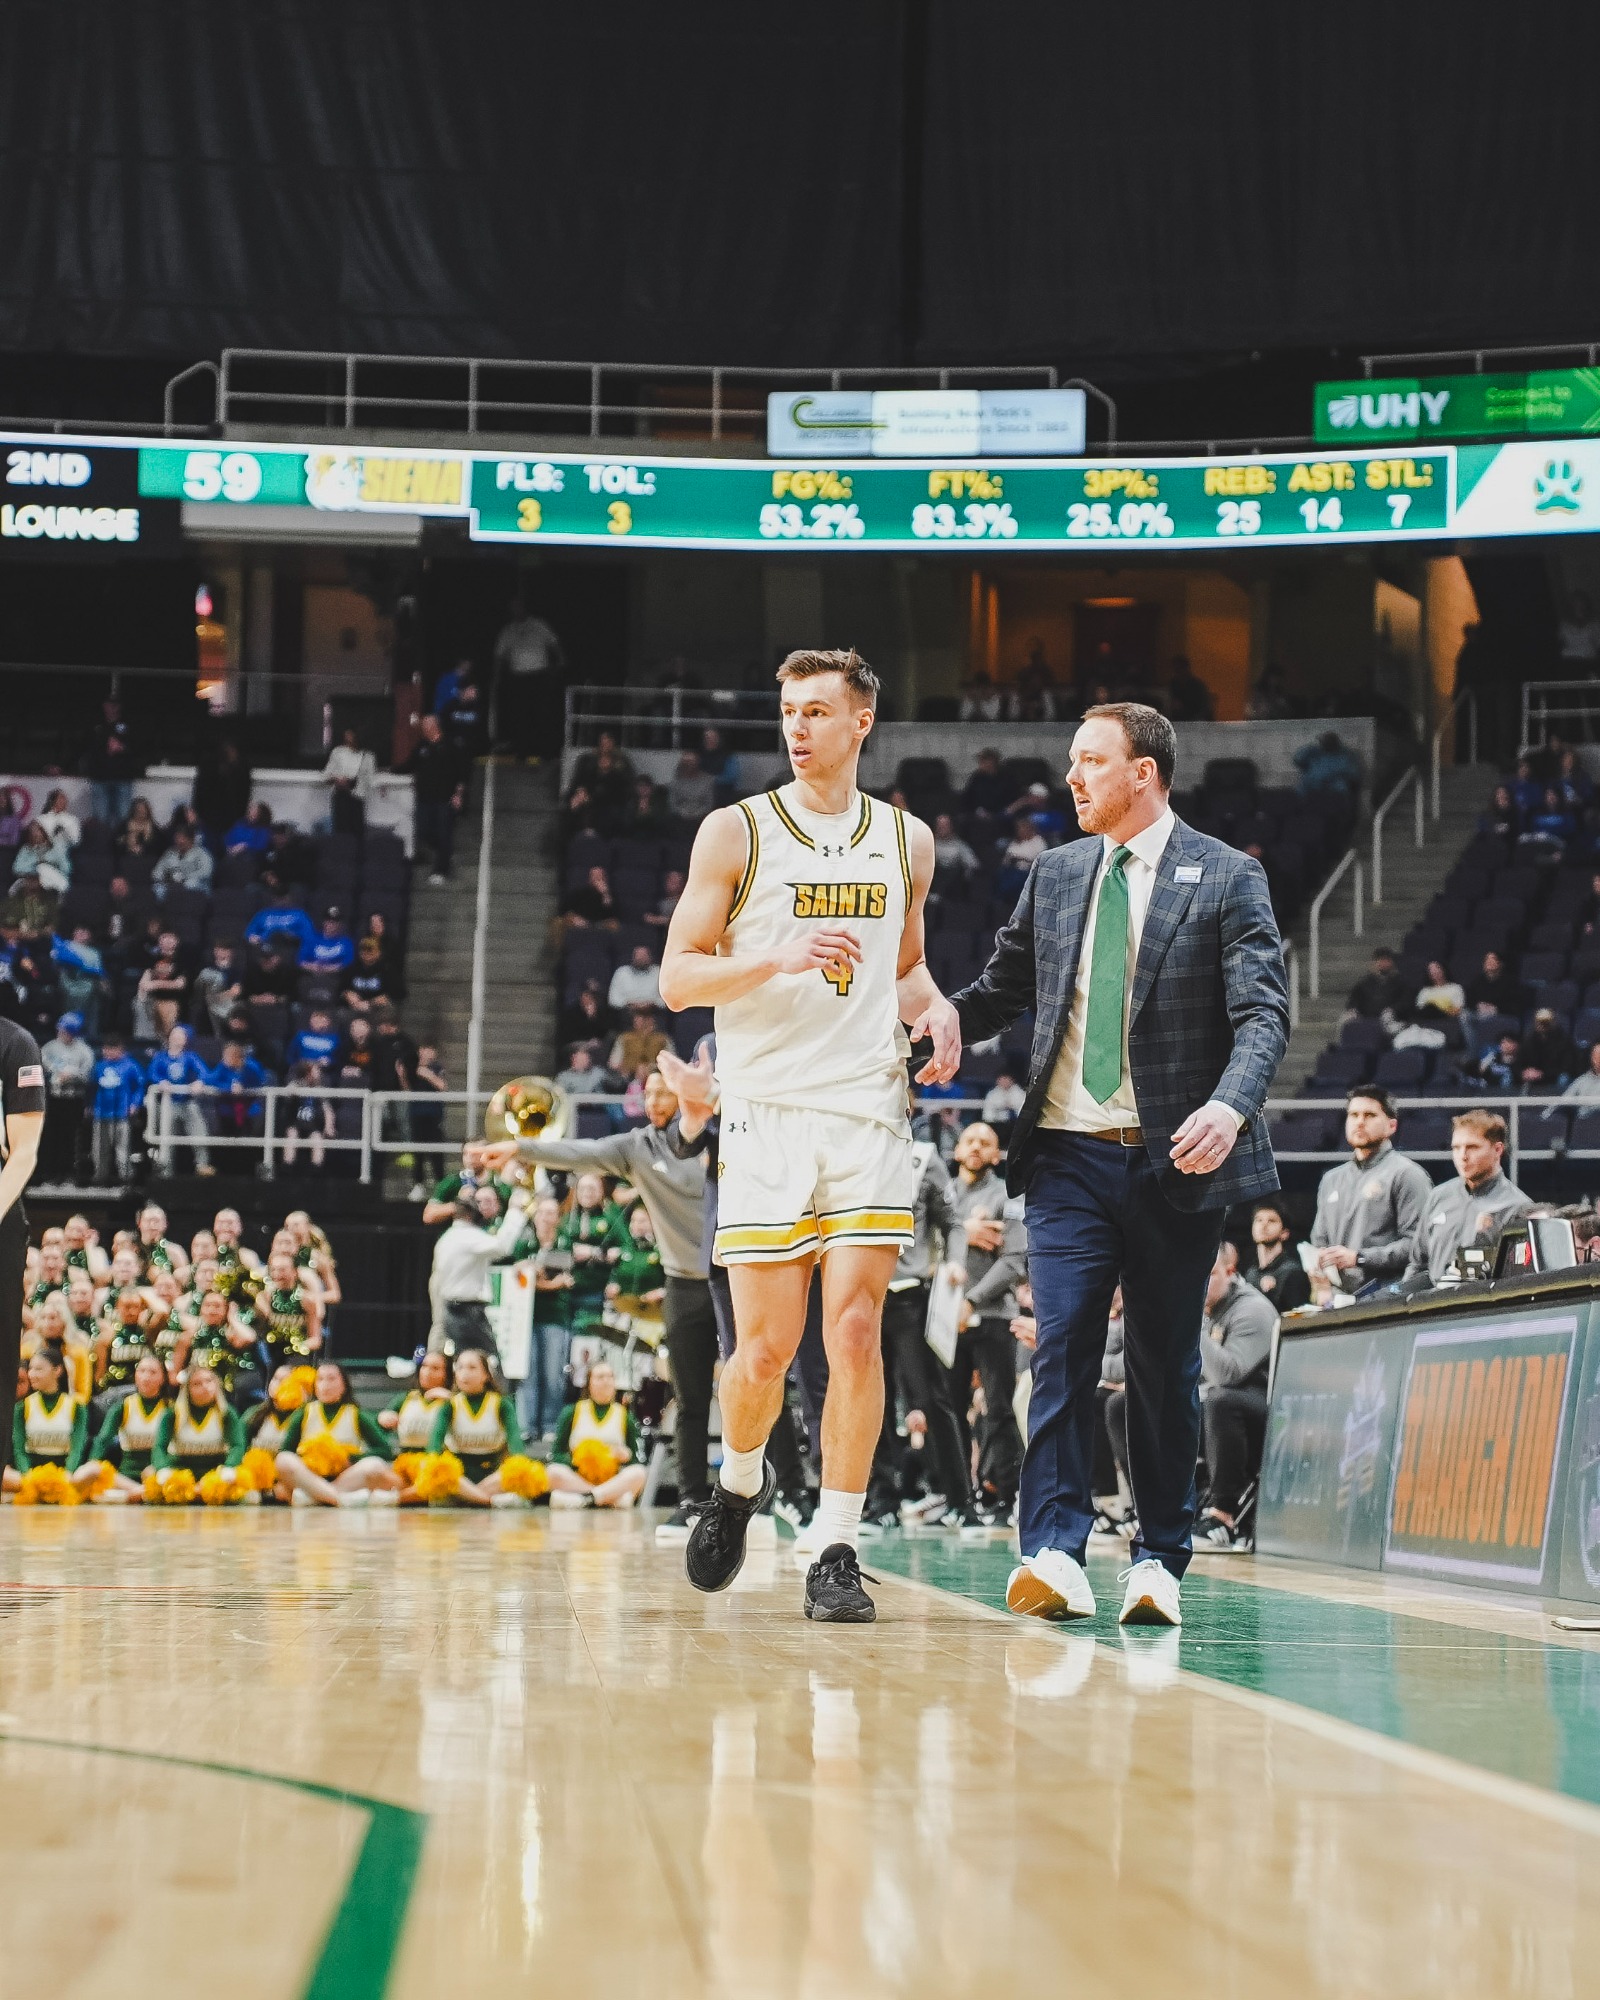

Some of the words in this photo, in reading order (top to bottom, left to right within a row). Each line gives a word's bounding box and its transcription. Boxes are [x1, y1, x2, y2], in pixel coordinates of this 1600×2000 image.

[1360, 391, 1450, 428] UHY
[6, 451, 91, 487] 2ND
[183, 452, 262, 501] 59
[358, 457, 463, 504] SIENA
[496, 462, 565, 492] FLS:
[584, 465, 656, 495] TOL:
[771, 470, 853, 499] FG%:
[928, 470, 1004, 499] FT%:
[1083, 469, 1160, 498] 3P%:
[1204, 466, 1277, 496] REB:
[1288, 462, 1355, 492] AST:
[1365, 459, 1433, 489] STL:
[1, 504, 139, 542] LOUNGE
[517, 498, 542, 532] 3
[607, 501, 632, 535] 3
[758, 504, 866, 539] 53.2%
[912, 503, 1018, 538] 83.3%
[1066, 503, 1175, 538] 25.0%
[1216, 501, 1261, 535] 25
[1300, 497, 1343, 532] 14
[1387, 494, 1412, 528] 7
[793, 883, 888, 919] SAINTS
